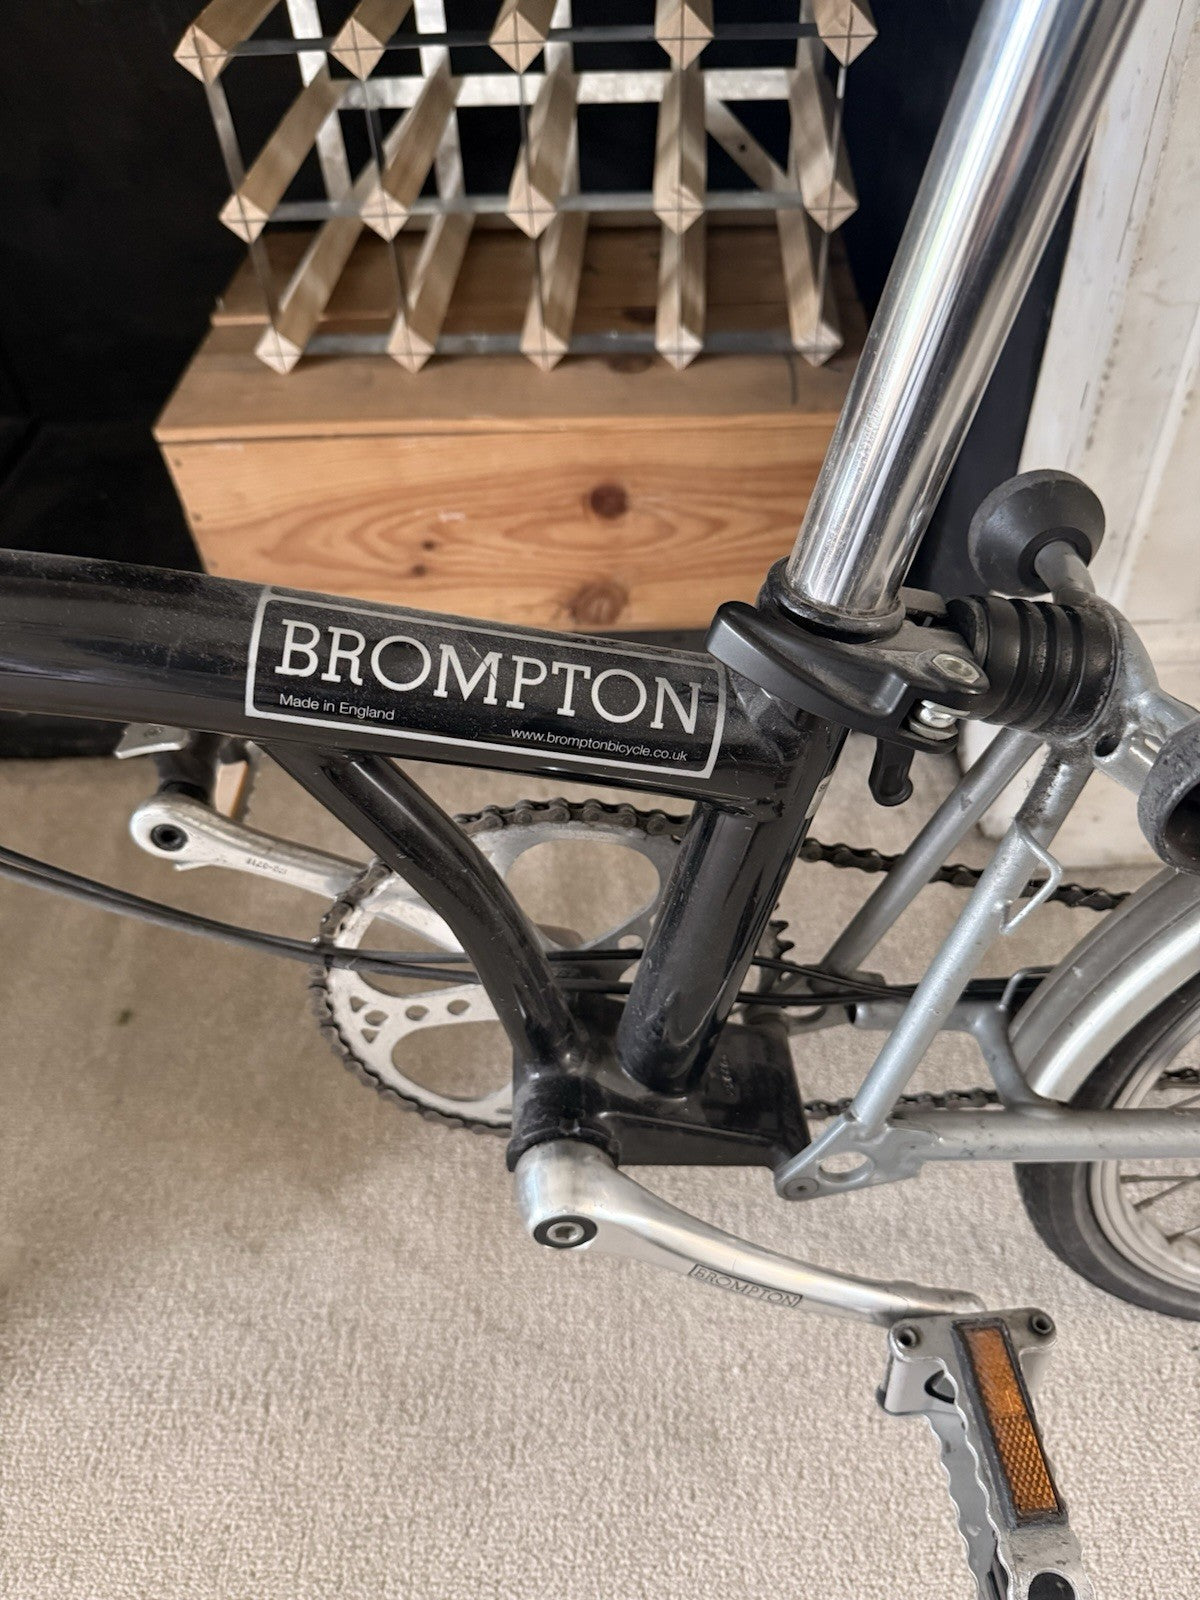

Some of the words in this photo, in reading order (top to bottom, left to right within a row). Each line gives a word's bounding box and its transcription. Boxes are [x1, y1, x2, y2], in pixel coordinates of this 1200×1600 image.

[274, 618, 702, 735] BROMPTON
[279, 693, 319, 711] Made
[322, 698, 335, 713] in
[339, 701, 395, 721] England
[510, 727, 688, 762] www.bromptonbicycle.co.uk
